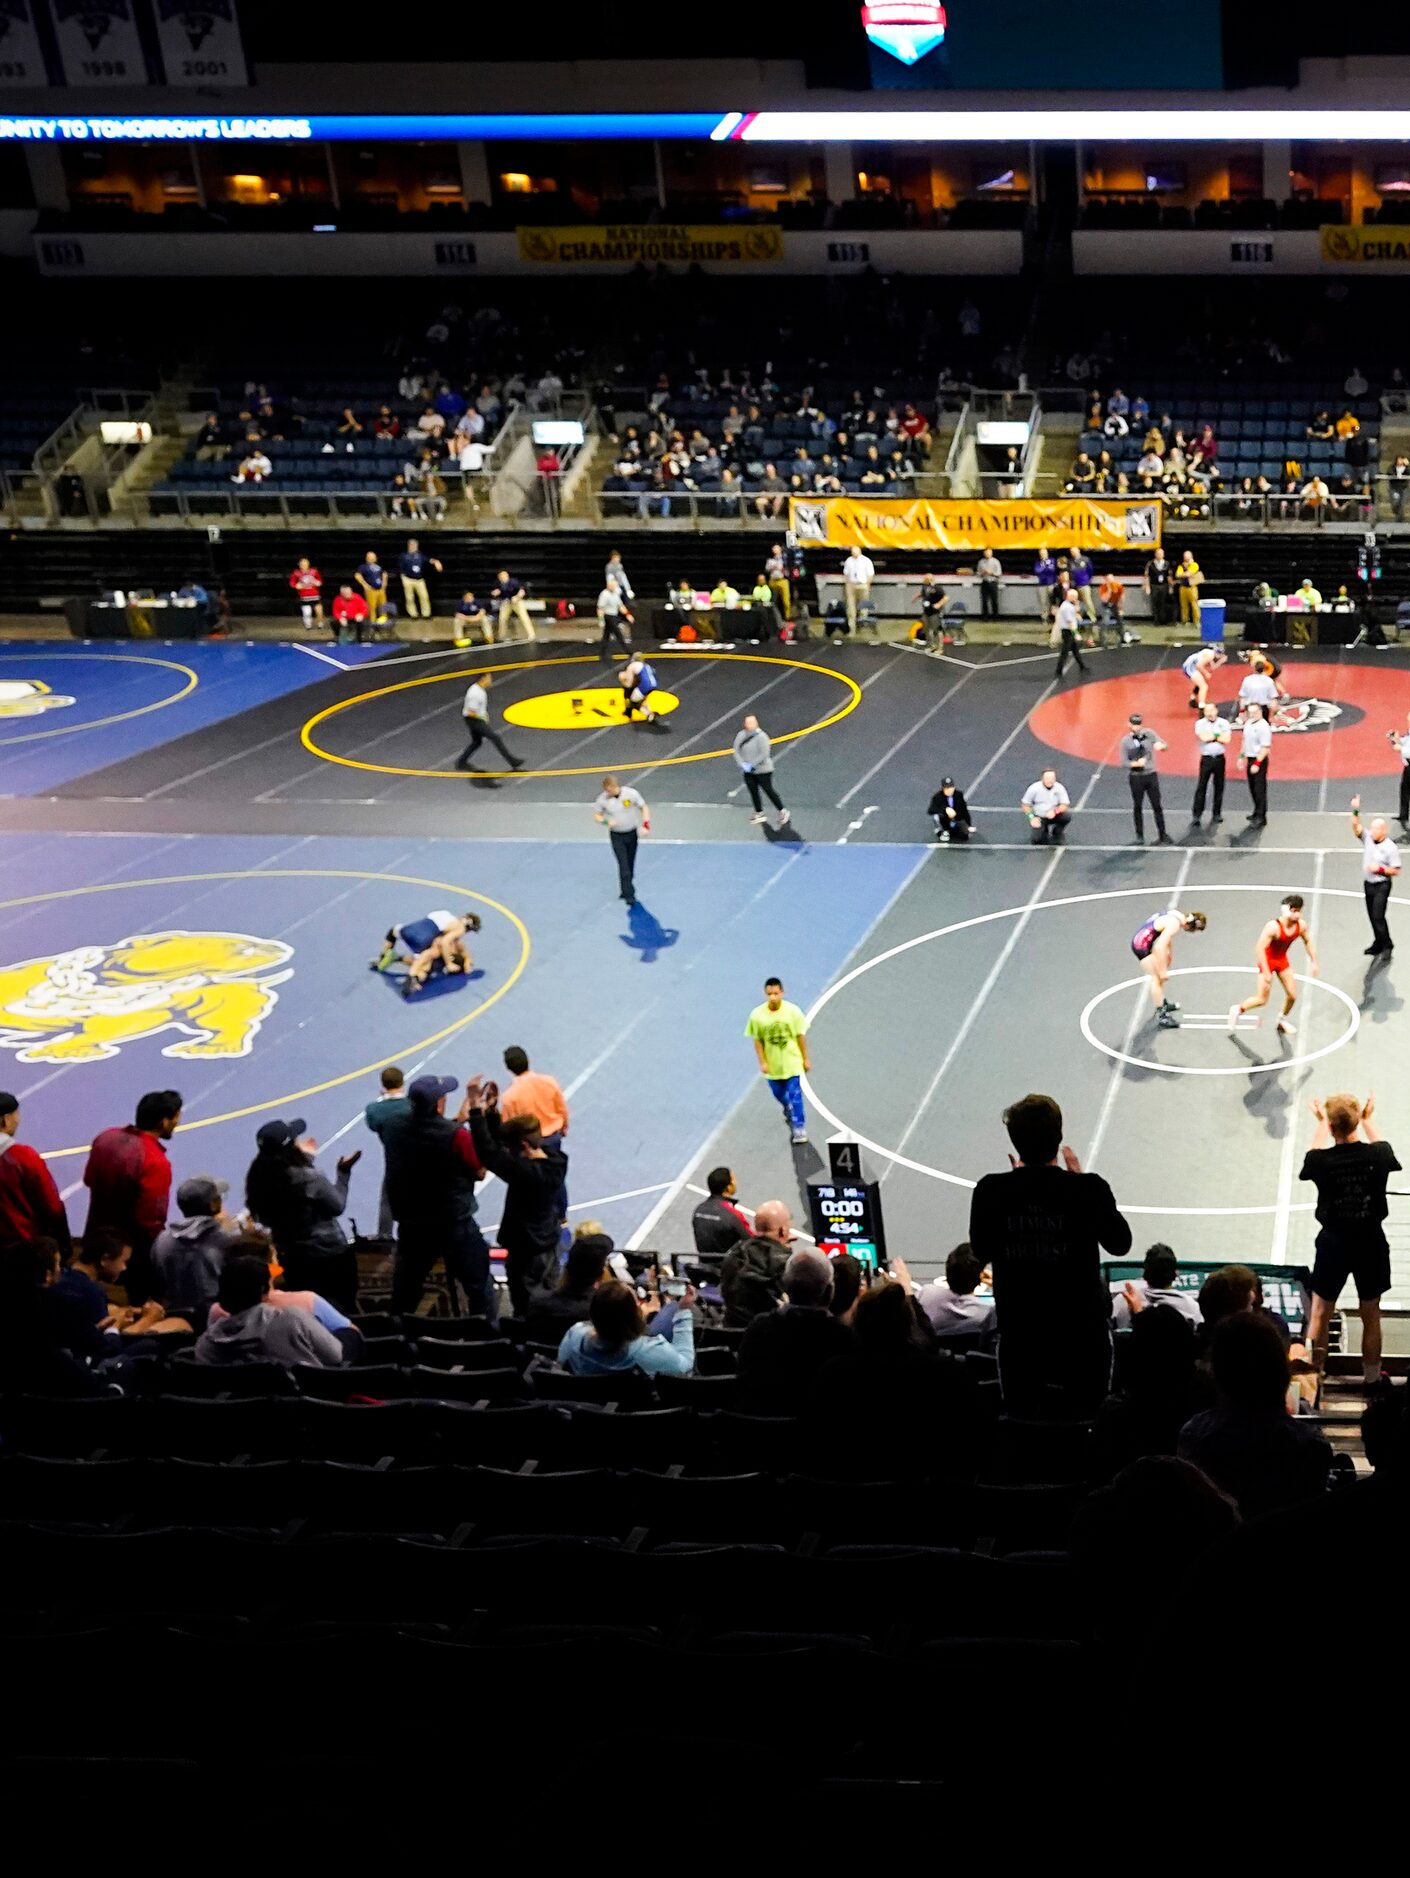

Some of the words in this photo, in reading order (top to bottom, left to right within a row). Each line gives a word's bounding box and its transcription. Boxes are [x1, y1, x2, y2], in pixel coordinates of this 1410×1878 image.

[0, 62, 26, 77] 93
[82, 61, 126, 76] 1998
[183, 61, 228, 76] 2001
[58, 119, 88, 138] TO
[88, 119, 220, 138] TOMORROW'S
[220, 119, 311, 138] LEADERS
[605, 226, 690, 241] NATIONAL
[559, 241, 741, 261] CHAMPIONSHIPS
[835, 512, 934, 533] NATIONAL
[941, 512, 1118, 534] CHAMPIONSHIPS
[835, 1146, 855, 1174] 4
[820, 1200, 864, 1217] 0:00
